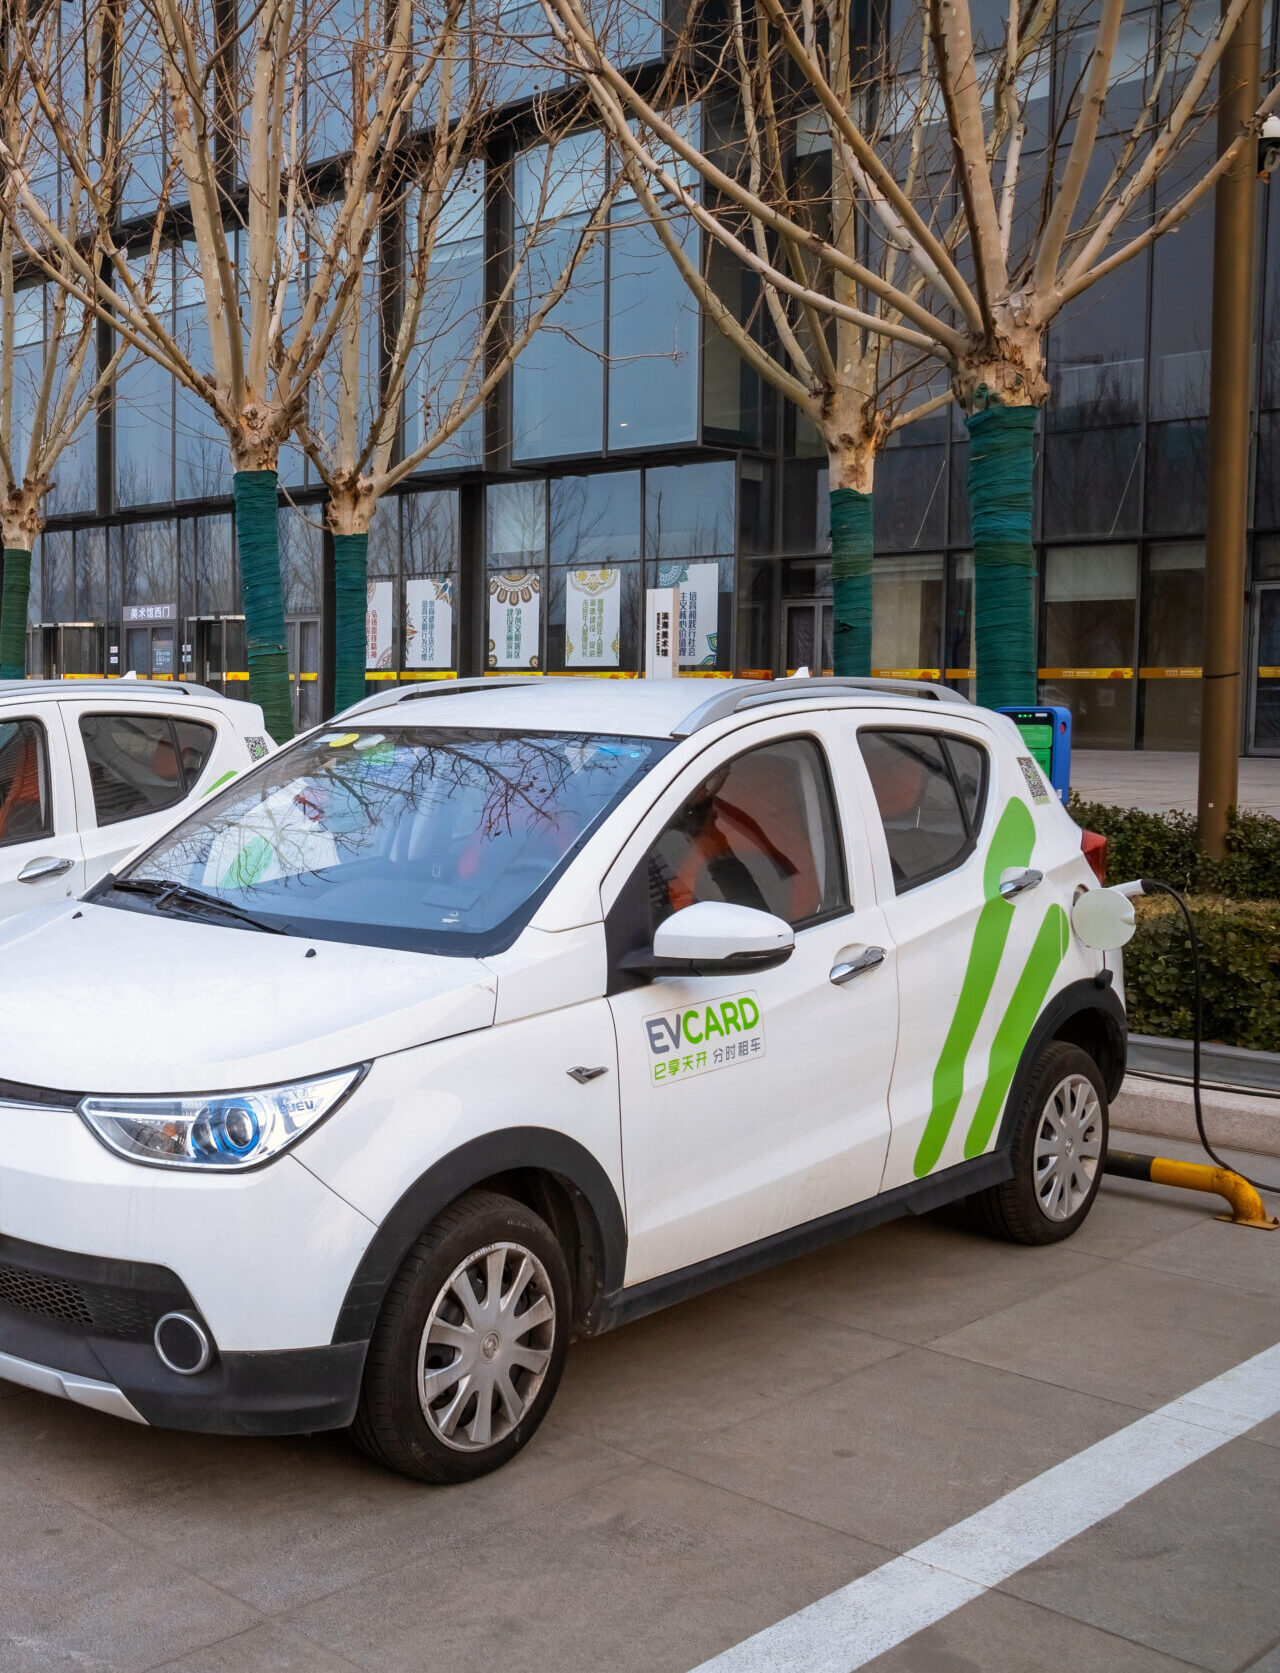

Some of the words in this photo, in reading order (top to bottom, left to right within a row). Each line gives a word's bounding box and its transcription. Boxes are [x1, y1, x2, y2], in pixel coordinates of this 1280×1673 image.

[130, 606, 170, 619] 美术馆西门
[661, 612, 669, 657] 滨海美术馆
[645, 997, 759, 1055] EVCARD
[712, 1037, 761, 1064] 分时租车
